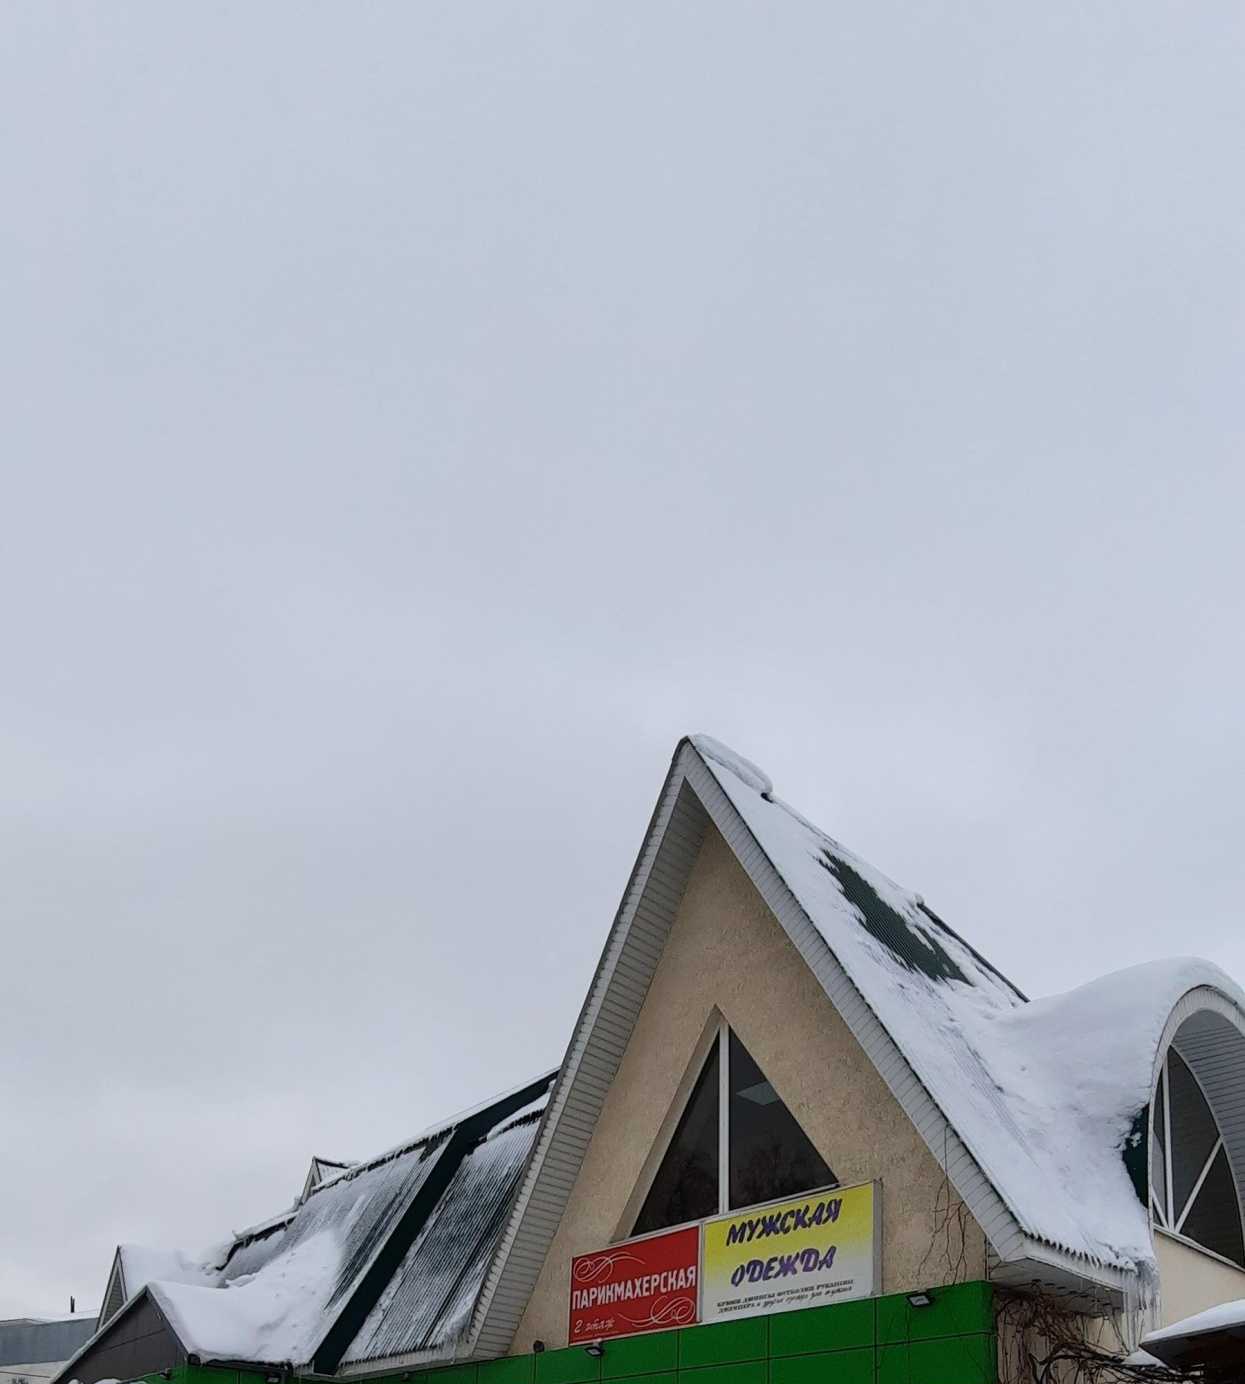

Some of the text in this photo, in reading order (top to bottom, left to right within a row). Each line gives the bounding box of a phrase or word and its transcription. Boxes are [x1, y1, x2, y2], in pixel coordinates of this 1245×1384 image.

[726, 1198, 842, 1247] МУЖСКАЯ
[572, 1265, 697, 1310] ПАРИКМАХЕРСКАЯ
[731, 1245, 837, 1287] ОДЕЖДА
[574, 1319, 583, 1334] 2
